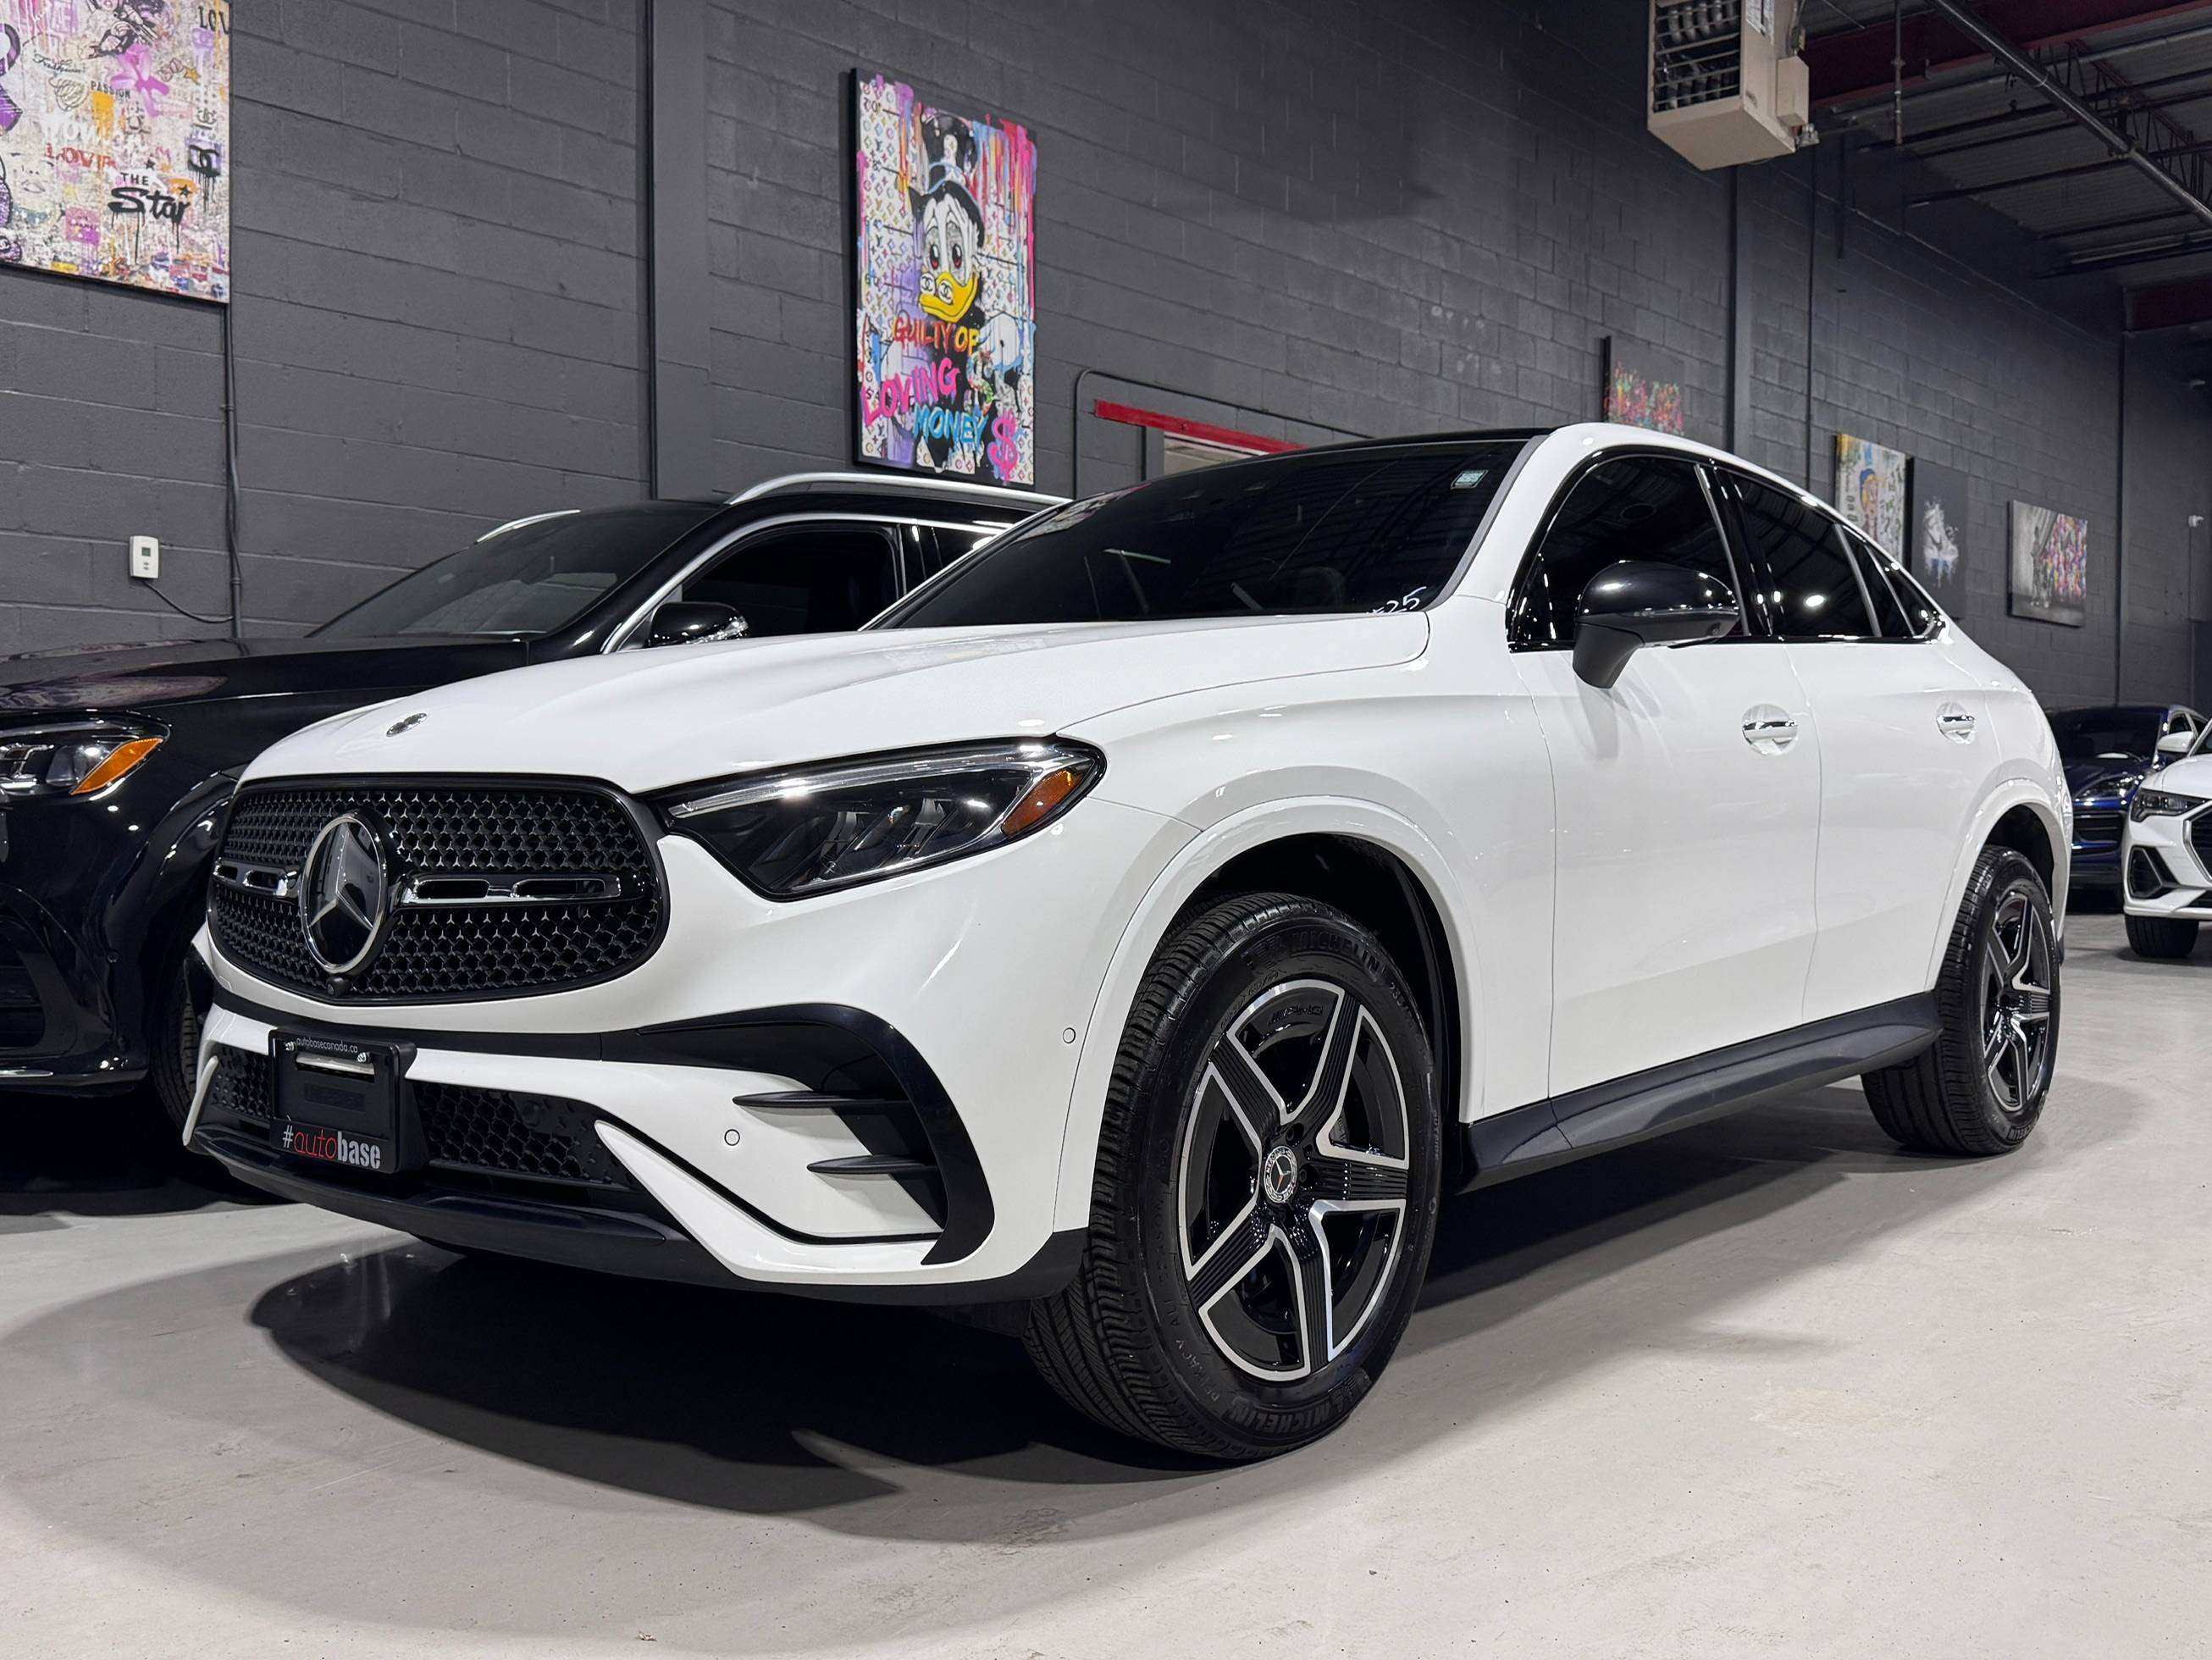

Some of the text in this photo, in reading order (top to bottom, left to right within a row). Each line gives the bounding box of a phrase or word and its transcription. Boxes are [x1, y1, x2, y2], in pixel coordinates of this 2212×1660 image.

[120, 172, 149, 186] THE
[108, 186, 191, 223] Star
[893, 315, 980, 355] GUILTY OF
[860, 357, 960, 428] LOVING
[912, 402, 990, 447] MONEY
[282, 1123, 382, 1170] #autobase
[1228, 1399, 1334, 1434] MICHELIN
